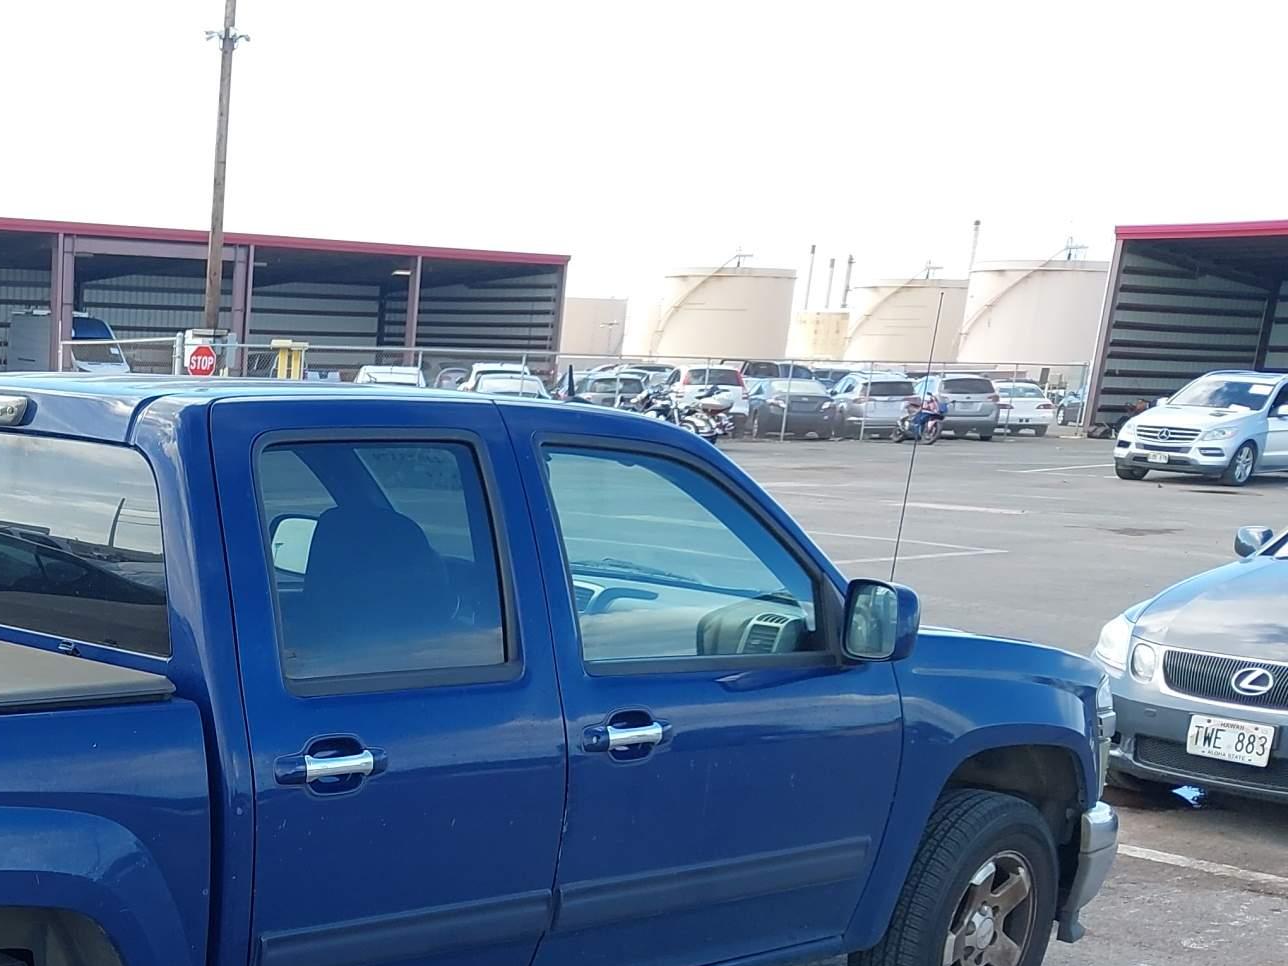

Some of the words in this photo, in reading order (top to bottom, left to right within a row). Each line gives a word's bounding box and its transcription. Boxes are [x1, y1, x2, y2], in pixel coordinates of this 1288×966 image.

[190, 356, 214, 370] STOP
[1194, 725, 1226, 749] TWE
[1234, 732, 1268, 756] 883
